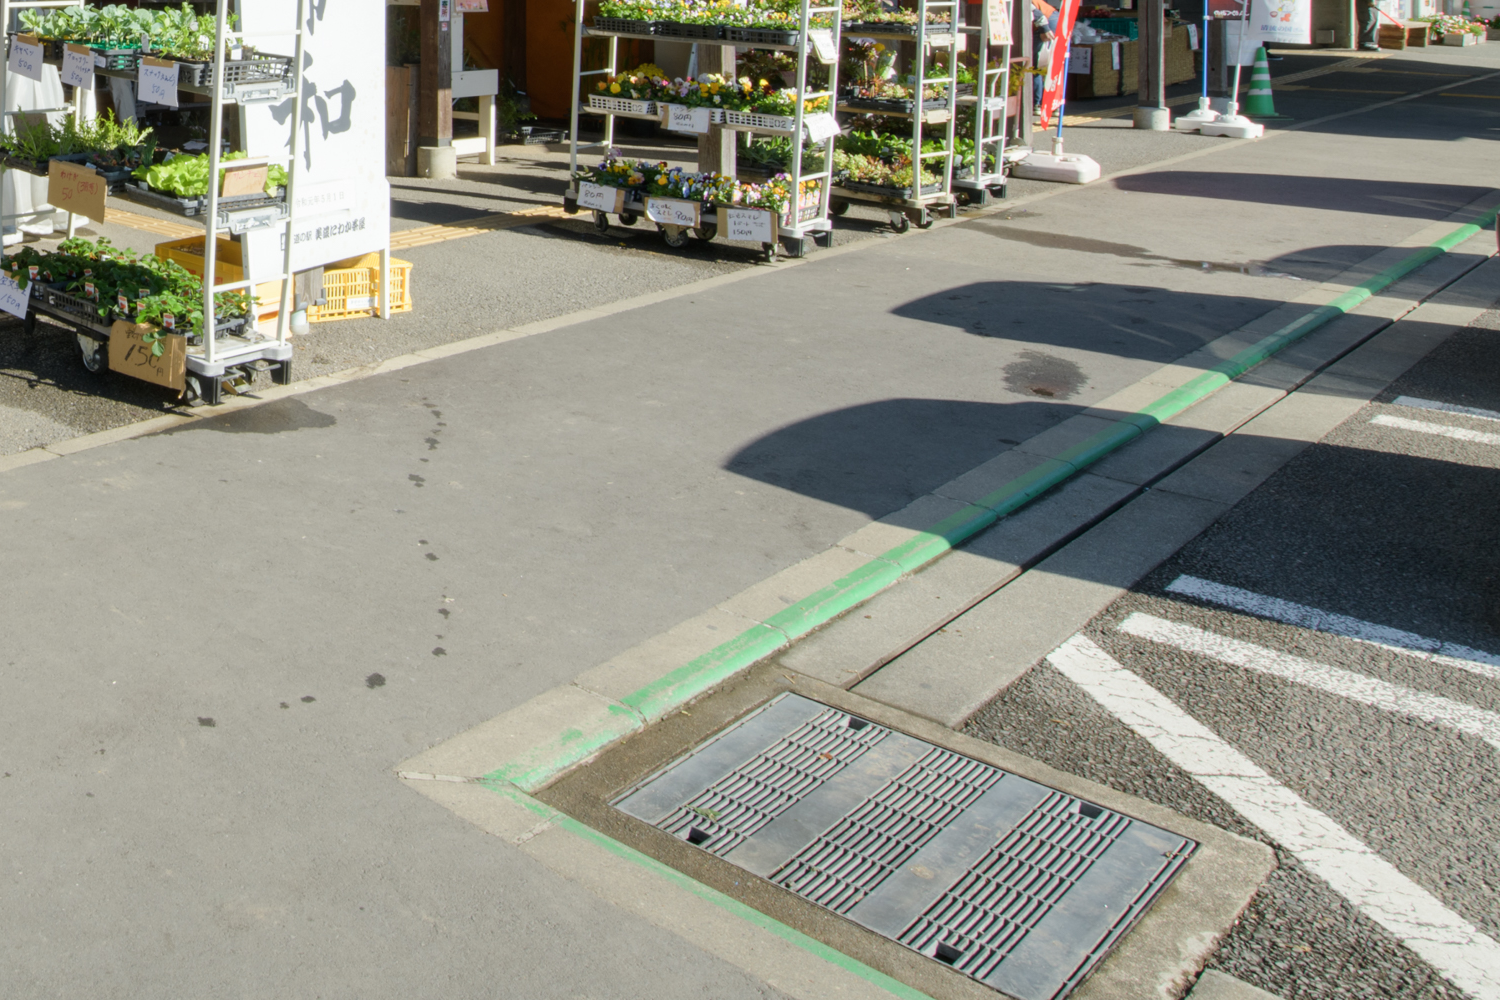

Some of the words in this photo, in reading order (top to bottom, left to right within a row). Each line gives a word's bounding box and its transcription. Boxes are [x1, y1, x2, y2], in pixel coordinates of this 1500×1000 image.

[294, 231, 312, 244] 道の駅
[315, 217, 365, 240] 美濃にわか茶屋
